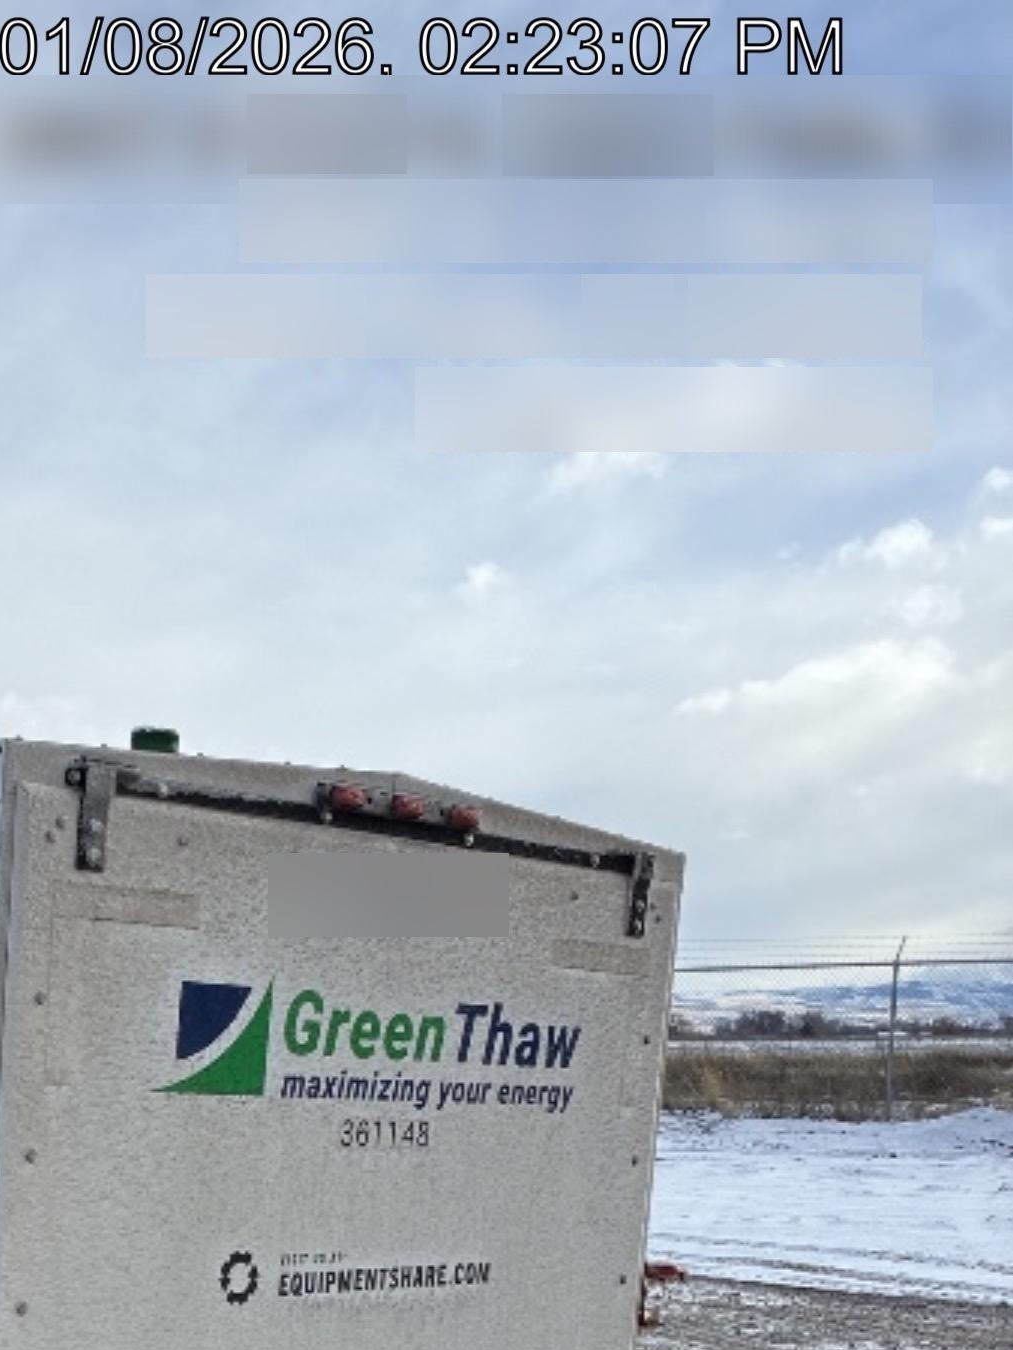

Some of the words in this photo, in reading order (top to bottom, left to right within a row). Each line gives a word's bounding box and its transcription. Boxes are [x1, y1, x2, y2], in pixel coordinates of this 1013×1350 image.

[280, 1070, 431, 1110] maximizing
[435, 1077, 492, 1110] your
[496, 1082, 574, 1113] energy
[340, 1118, 429, 1147] 361148
